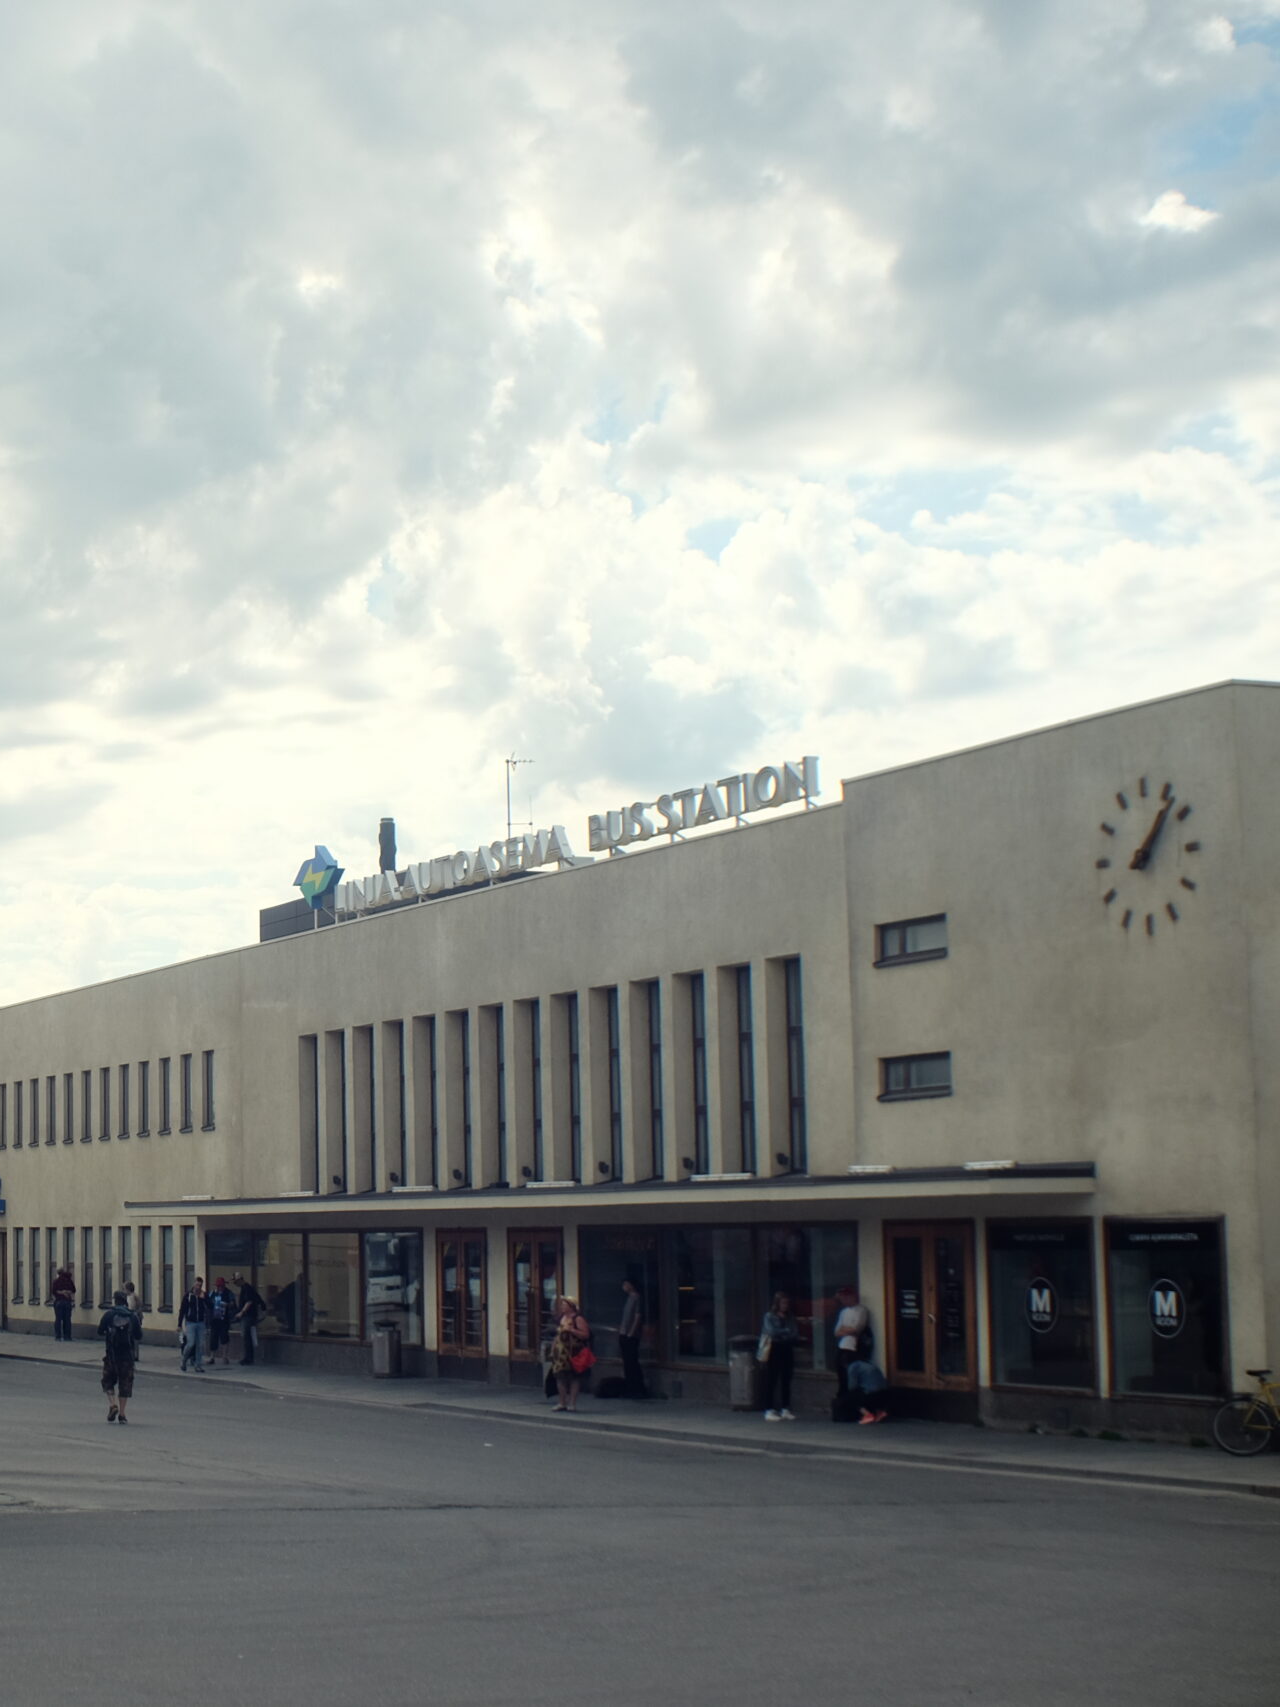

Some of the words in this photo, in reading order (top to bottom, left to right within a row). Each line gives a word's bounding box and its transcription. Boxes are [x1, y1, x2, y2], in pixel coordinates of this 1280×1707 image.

[334, 825, 575, 914] LINJA-AUTOASEMA
[588, 801, 653, 852] BUS
[656, 755, 820, 834] STATION
[1030, 1287, 1051, 1313] M
[1154, 1290, 1178, 1317] M
